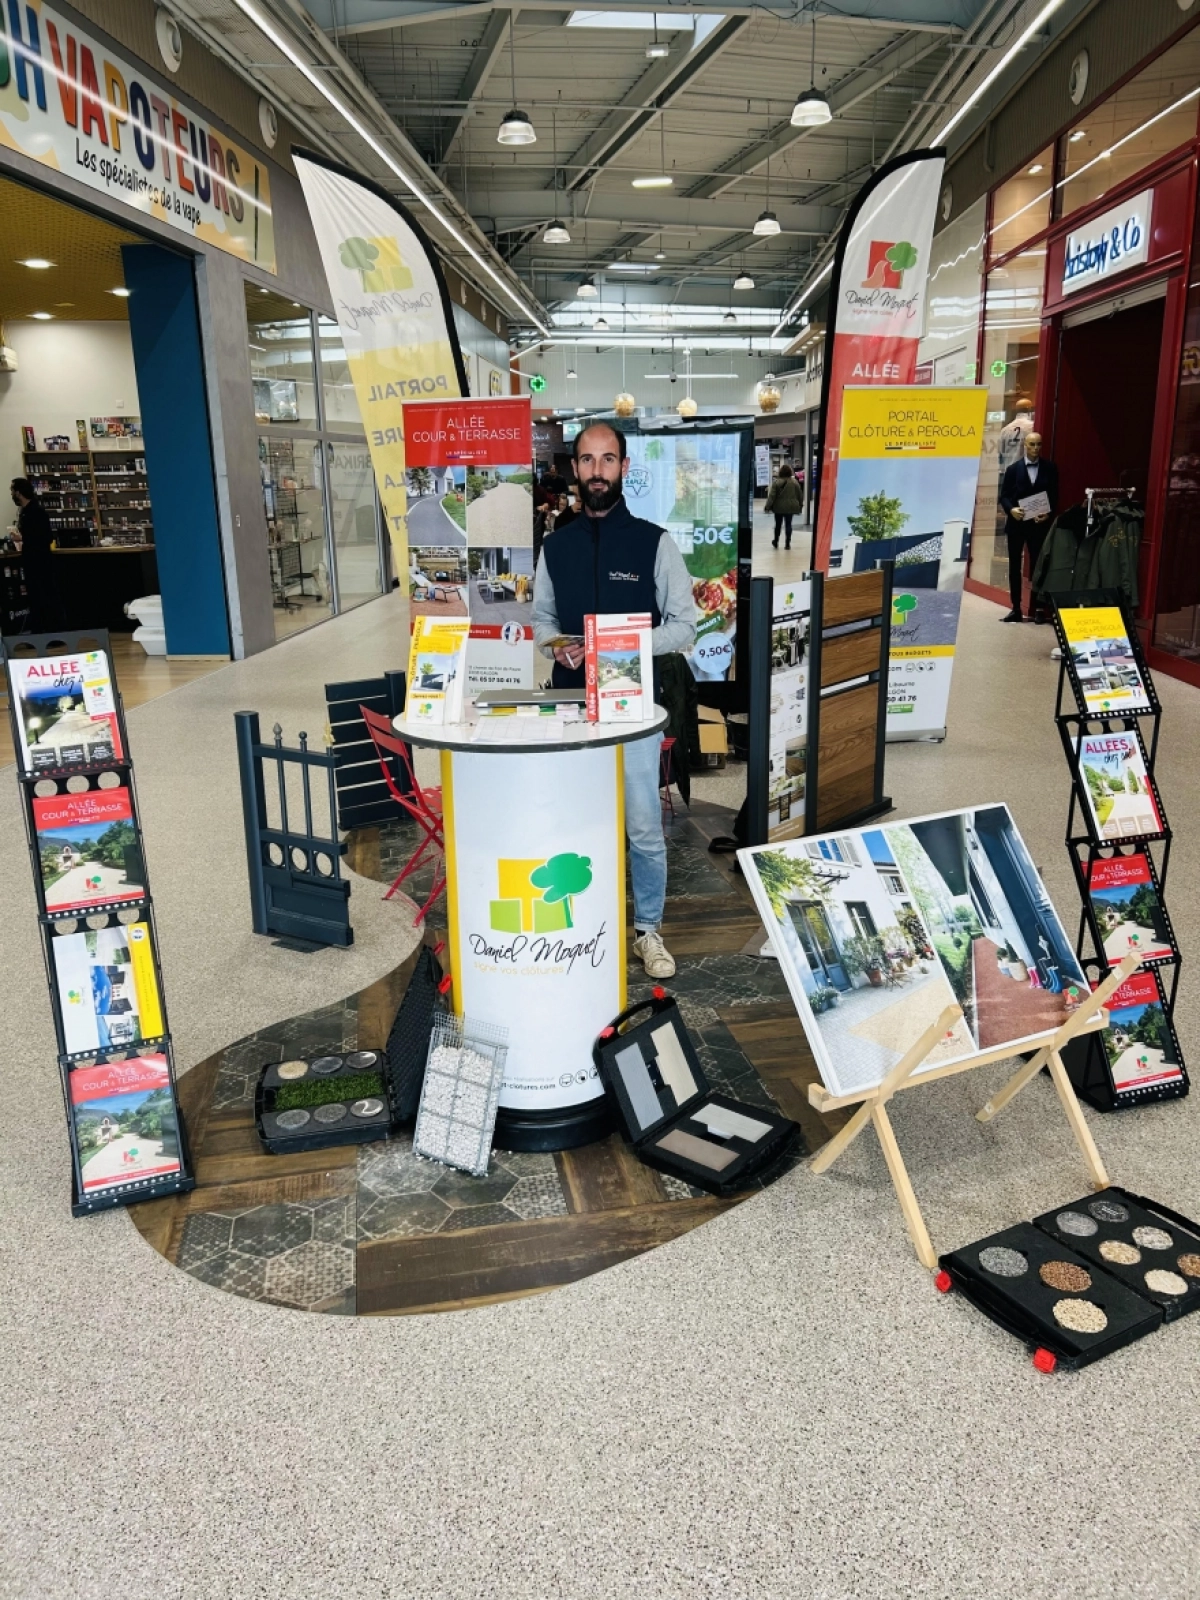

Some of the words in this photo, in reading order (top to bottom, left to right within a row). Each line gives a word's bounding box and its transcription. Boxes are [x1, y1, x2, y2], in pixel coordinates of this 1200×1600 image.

[76, 138, 97, 173] Les
[100, 156, 160, 205] spécialistes
[160, 188, 172, 210] de
[173, 191, 181, 216] la
[182, 203, 201, 230] vape
[1110, 226, 1121, 260] &
[1123, 216, 1141, 252] Co
[852, 360, 900, 379] ALLÉE
[446, 414, 485, 429] ALLÉE
[888, 411, 938, 423] PORTAIL
[413, 430, 446, 443] COUR
[449, 433, 456, 441] &
[458, 428, 521, 441] TERRASSE
[848, 424, 906, 438] CLÔTURE
[917, 425, 976, 438] PERGOLA
[1014, 427, 1021, 442] 2
[587, 618, 595, 654] Terrasse
[699, 644, 732, 658] 9,50€
[587, 664, 596, 686] Cour
[41, 809, 69, 821] COUR
[78, 803, 123, 816] TERRASSE
[1090, 874, 1106, 882] OUR
[469, 933, 528, 963] Daniel
[530, 920, 606, 975] Moquet
[473, 961, 498, 974] signe
[500, 965, 518, 976] vos
[521, 963, 565, 977] clôtures
[83, 1080, 109, 1091] COUR
